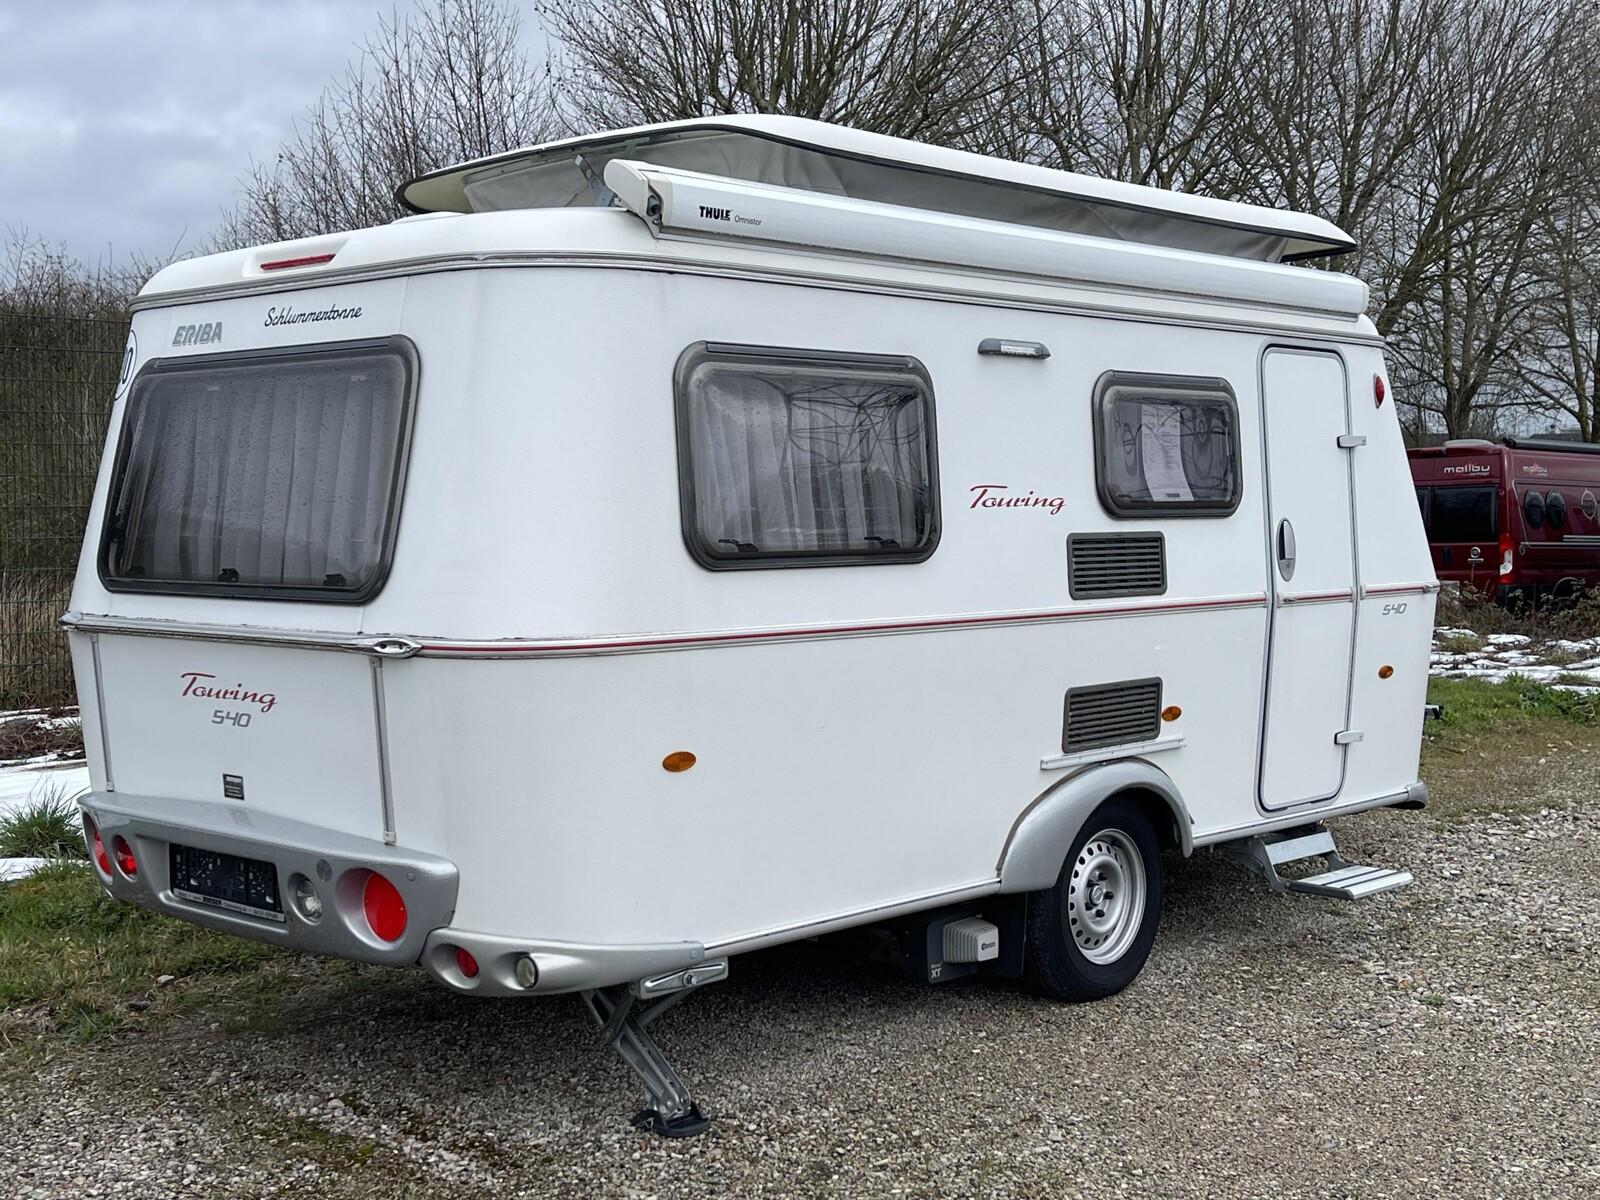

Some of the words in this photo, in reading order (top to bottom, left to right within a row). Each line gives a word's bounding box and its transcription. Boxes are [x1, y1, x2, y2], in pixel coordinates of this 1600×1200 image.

[699, 205, 731, 221] THULE
[734, 215, 762, 226] Omnistor
[264, 304, 362, 327] Schlummertonne
[172, 322, 223, 347] ERIBA
[1443, 464, 1491, 473] malibu
[969, 484, 1065, 515] Touring
[1382, 603, 1407, 616] 540
[180, 672, 278, 713] Touring
[211, 709, 252, 727] 540
[931, 967, 942, 979] XT
